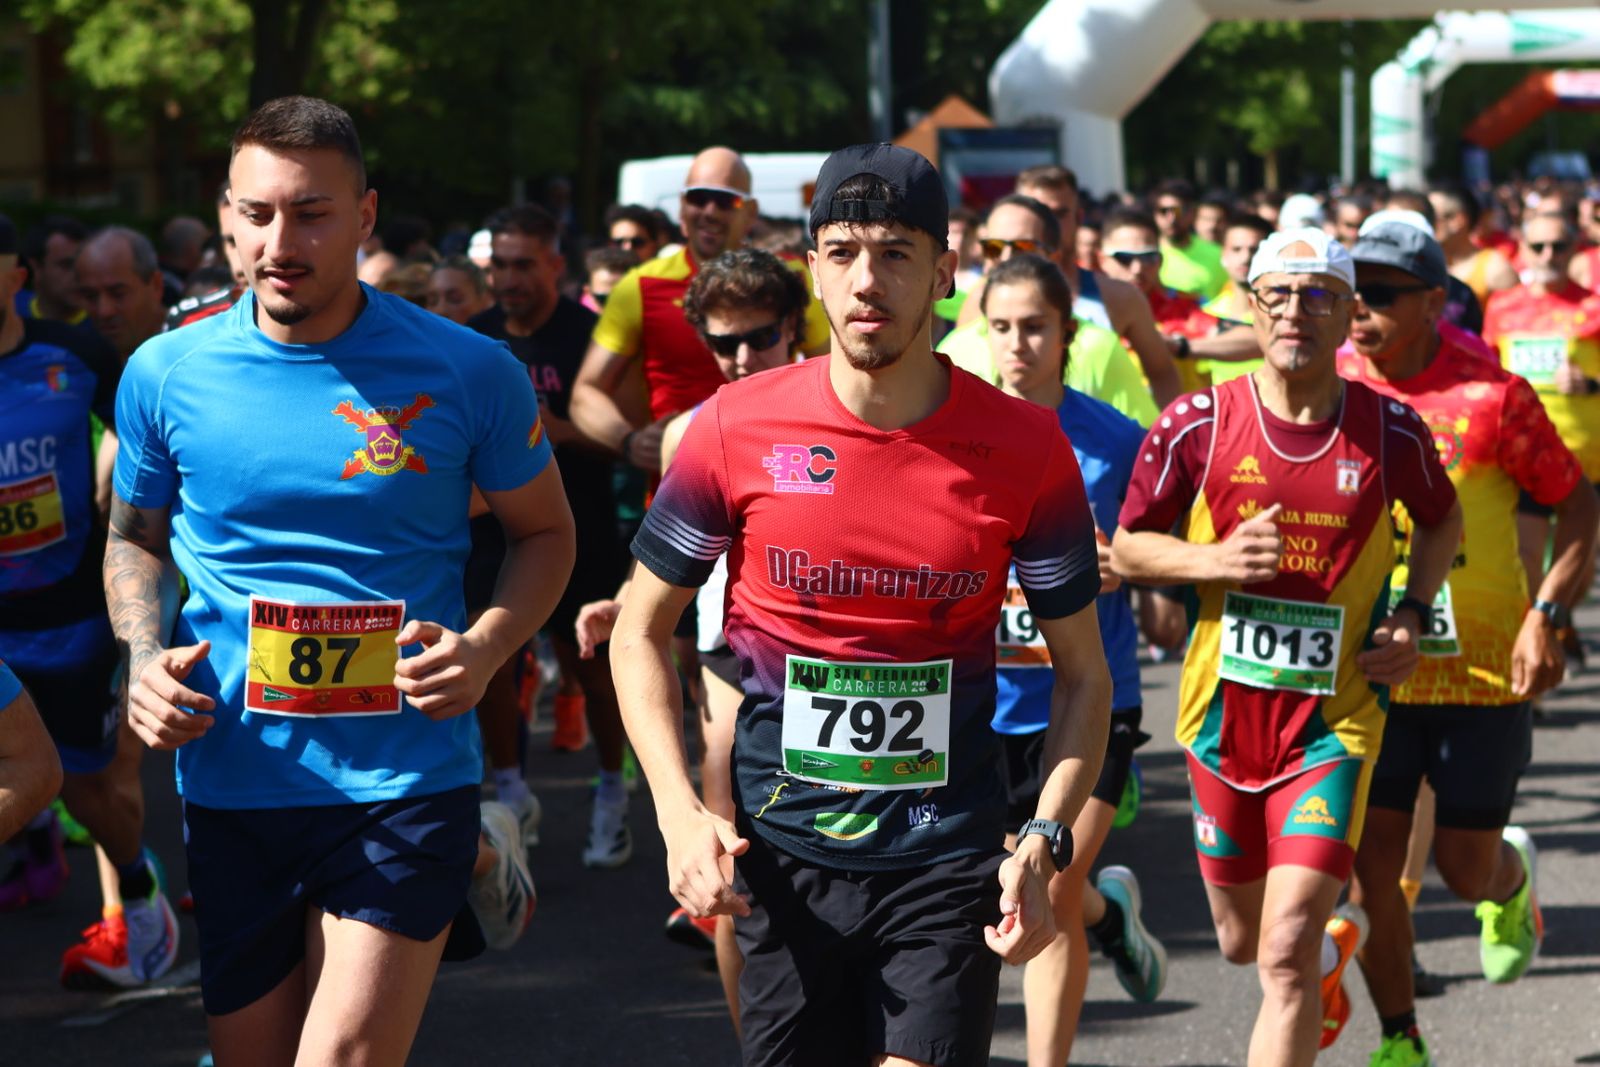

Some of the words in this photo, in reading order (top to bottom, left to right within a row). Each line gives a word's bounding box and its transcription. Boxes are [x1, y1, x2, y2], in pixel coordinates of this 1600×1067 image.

[0, 436, 57, 477] MSC
[772, 444, 837, 484] RC
[1304, 511, 1349, 528] RURAL
[765, 544, 989, 600] DCabrerizos
[254, 602, 289, 627] XIV
[292, 608, 319, 619] SAN
[291, 617, 362, 631] CARRERA
[1229, 618, 1334, 668] 1013
[289, 637, 361, 686] 87
[834, 667, 862, 680] SAN
[832, 680, 908, 694] CARRERA
[811, 696, 925, 753] 792
[907, 802, 940, 826] MSC
